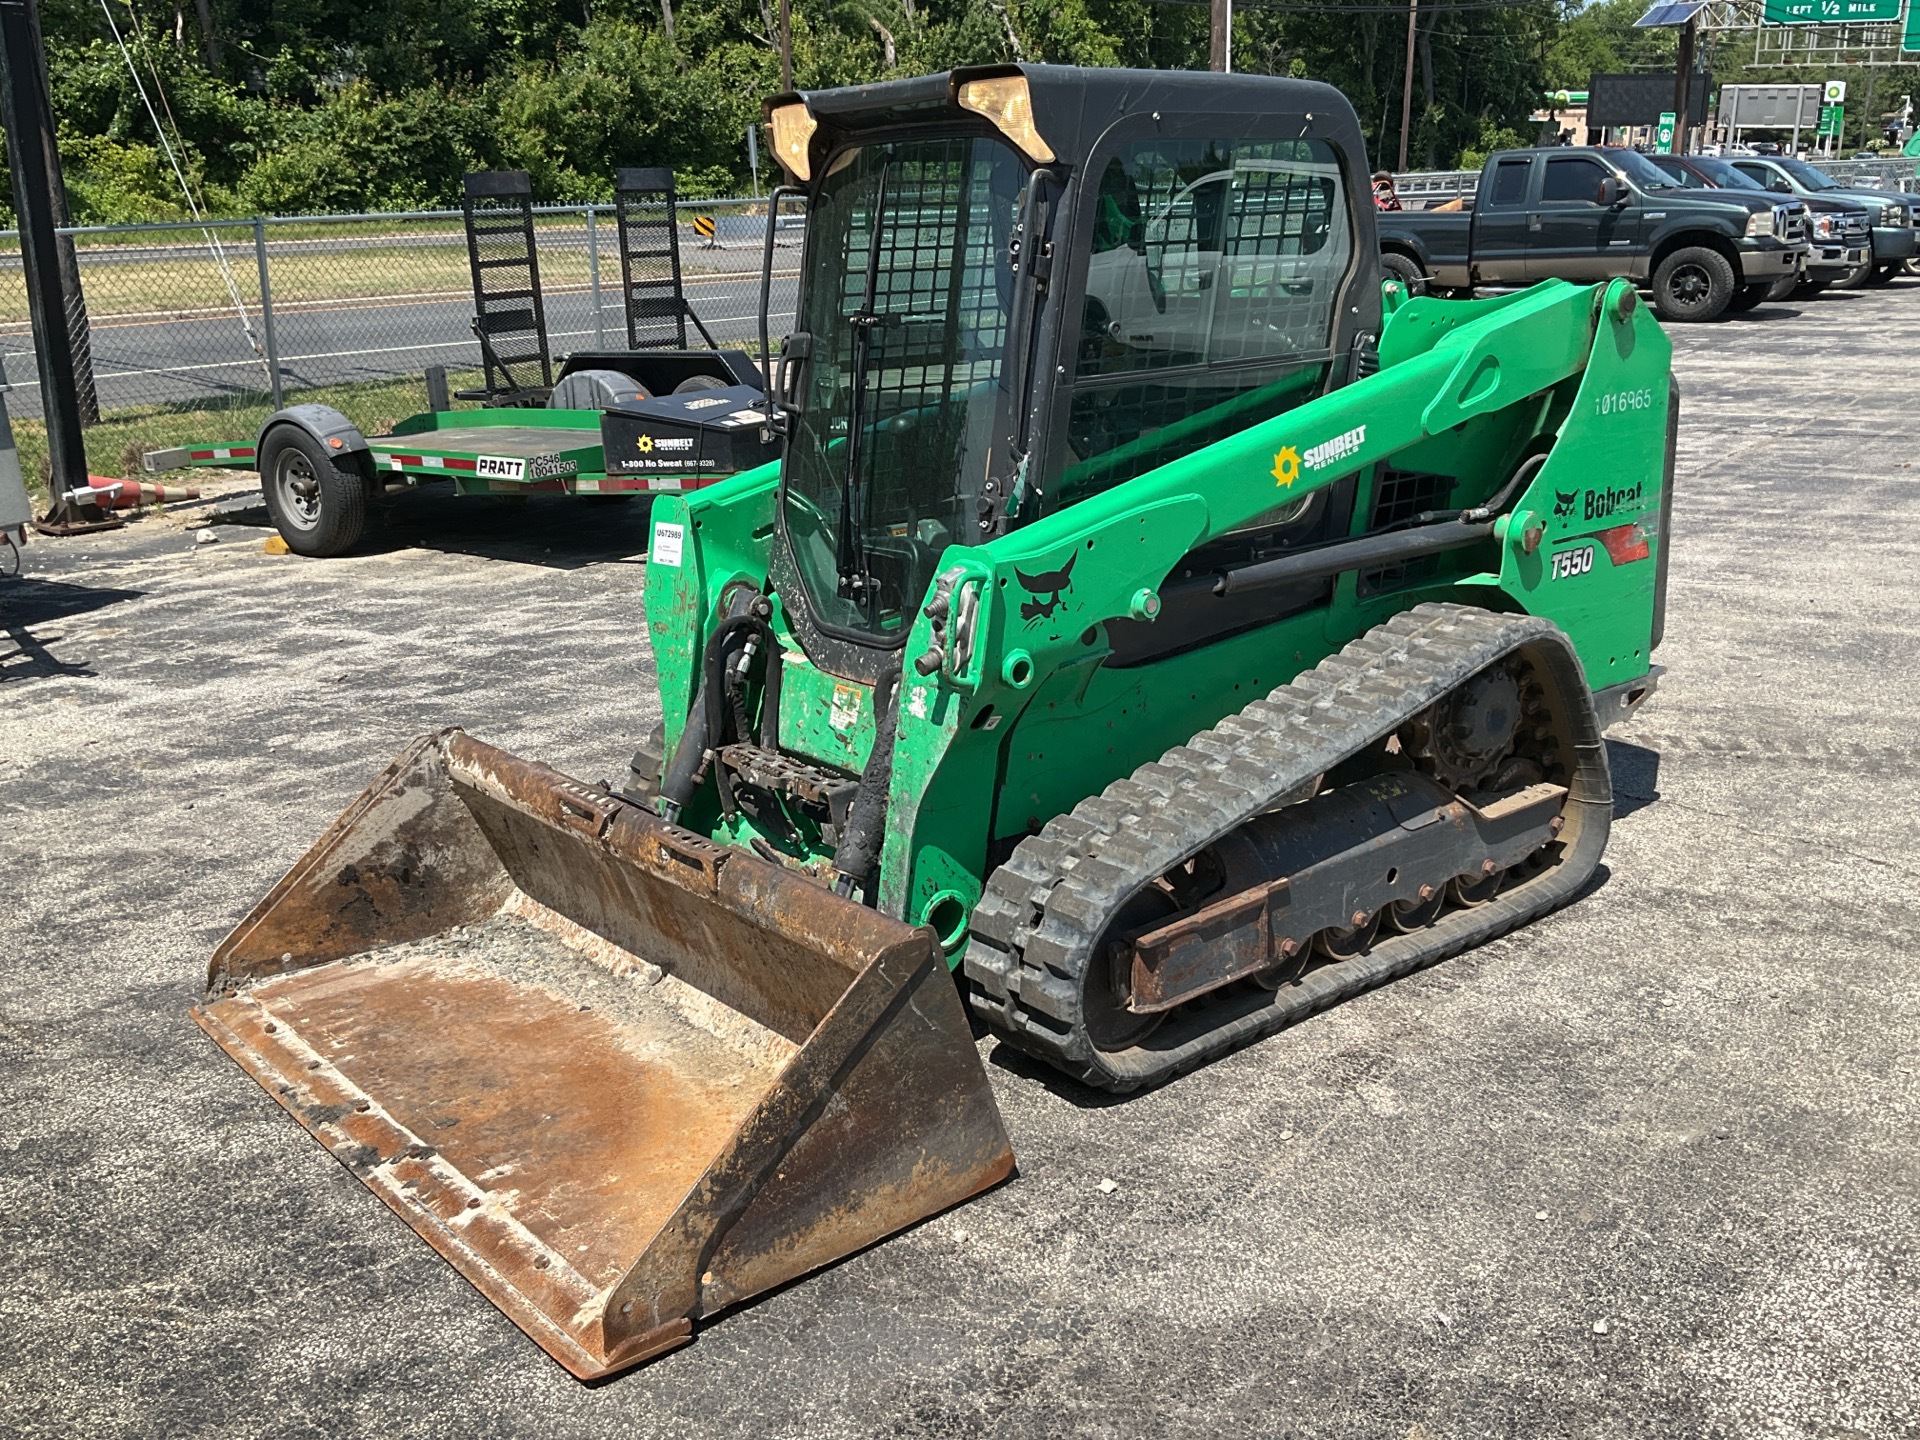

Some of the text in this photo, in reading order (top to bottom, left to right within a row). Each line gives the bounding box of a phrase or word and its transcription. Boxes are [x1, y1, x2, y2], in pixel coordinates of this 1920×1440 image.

[1786, 0, 1876, 15] LEFT 1/2 MILE
[654, 438, 694, 448] SUNBELT
[1303, 424, 1366, 468] SUNBELT
[529, 454, 560, 468] PC546
[621, 460, 644, 468] 1-800
[645, 460, 657, 468] No
[658, 460, 682, 468] Sweat
[1313, 445, 1359, 471] RENTALS
[479, 459, 522, 476] PRATT
[530, 461, 577, 479] 10041503
[1584, 481, 1642, 521] Bobcat
[1551, 545, 1594, 581] T550
